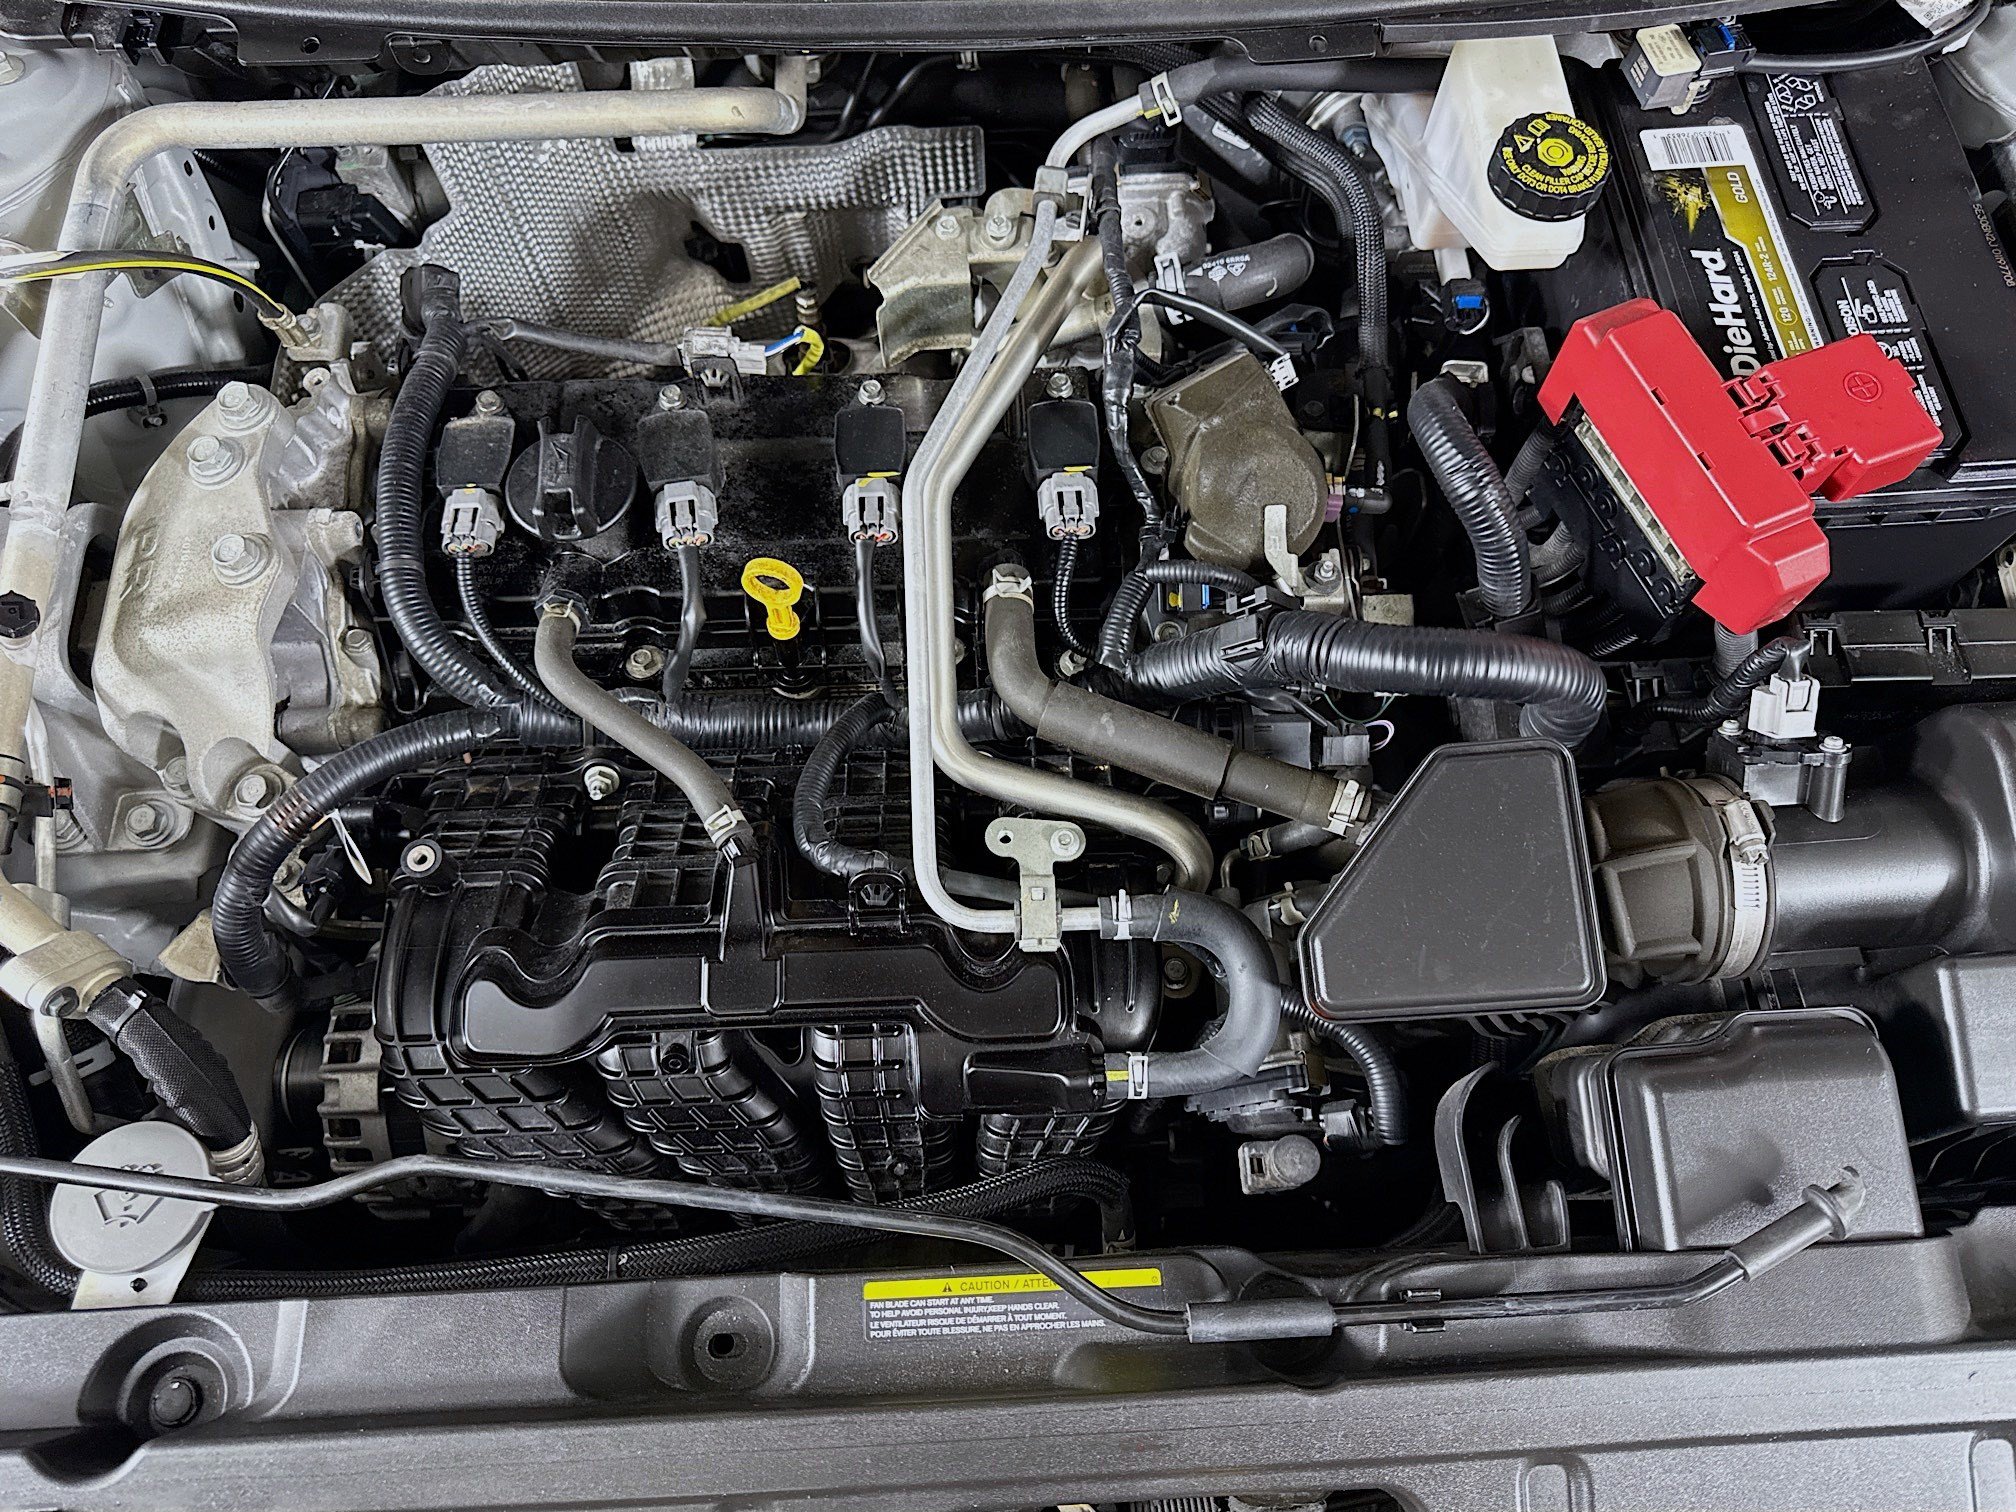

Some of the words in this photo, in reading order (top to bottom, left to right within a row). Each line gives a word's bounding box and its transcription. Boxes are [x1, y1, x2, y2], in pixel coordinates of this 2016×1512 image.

[1568, 126, 1596, 153] REMOVING
[1810, 138, 1821, 151] FAST
[1804, 143, 1814, 154] GET
[1518, 171, 1537, 187] DOT3
[1536, 182, 1548, 192] OR
[1548, 185, 1568, 194] DOT4
[1568, 179, 1593, 193] BRAKE
[1584, 126, 1605, 149] SEALED
[1583, 154, 1598, 177] BEFORE
[1802, 158, 1813, 172] EYES
[1815, 151, 1826, 165] HELP
[1522, 164, 1545, 181] CLEAN
[1545, 175, 1570, 185] FILLER
[1570, 173, 1585, 184] CAP
[1820, 166, 1835, 189] MEDICAL
[1725, 172, 1749, 203] GOLD
[1807, 172, 1820, 190] FLUSH
[1816, 175, 1827, 189] WITH
[1752, 307, 1763, 319] Auto
[1777, 306, 1793, 322] 120
[1835, 298, 1860, 335] OISON
[1757, 320, 1771, 341] Advance
[1890, 345, 1901, 356] NO
[960, 1279, 1011, 1292] CAUTION
[1022, 1276, 1057, 1289] ATTEN
[881, 1309, 900, 1317] HELP
[900, 1309, 923, 1317] AVOID
[924, 1307, 963, 1315] PERSONAL
[1007, 1303, 1033, 1311] HANDS
[1034, 1301, 1059, 1310] CLEAR.
[885, 1300, 909, 1308] BLADE
[959, 1296, 974, 1304] ANY
[880, 1319, 926, 1328] VENTILATEUR
[927, 1317, 954, 1326] RISQUE
[966, 1314, 1006, 1323] DÉMARRER
[1007, 1312, 1013, 1321] À
[1013, 1313, 1032, 1321] TOUT
[1033, 1311, 1067, 1320] MOMENT.
[870, 1330, 891, 1338] POUR
[892, 1328, 917, 1337] ÉVITER
[917, 1327, 941, 1335] TOUTE
[941, 1325, 981, 1334] BLESSURE,
[1020, 1321, 1065, 1330] APPROCHER
[1066, 1320, 1080, 1328] LES
[1081, 1319, 1105, 1327] MAINS.
